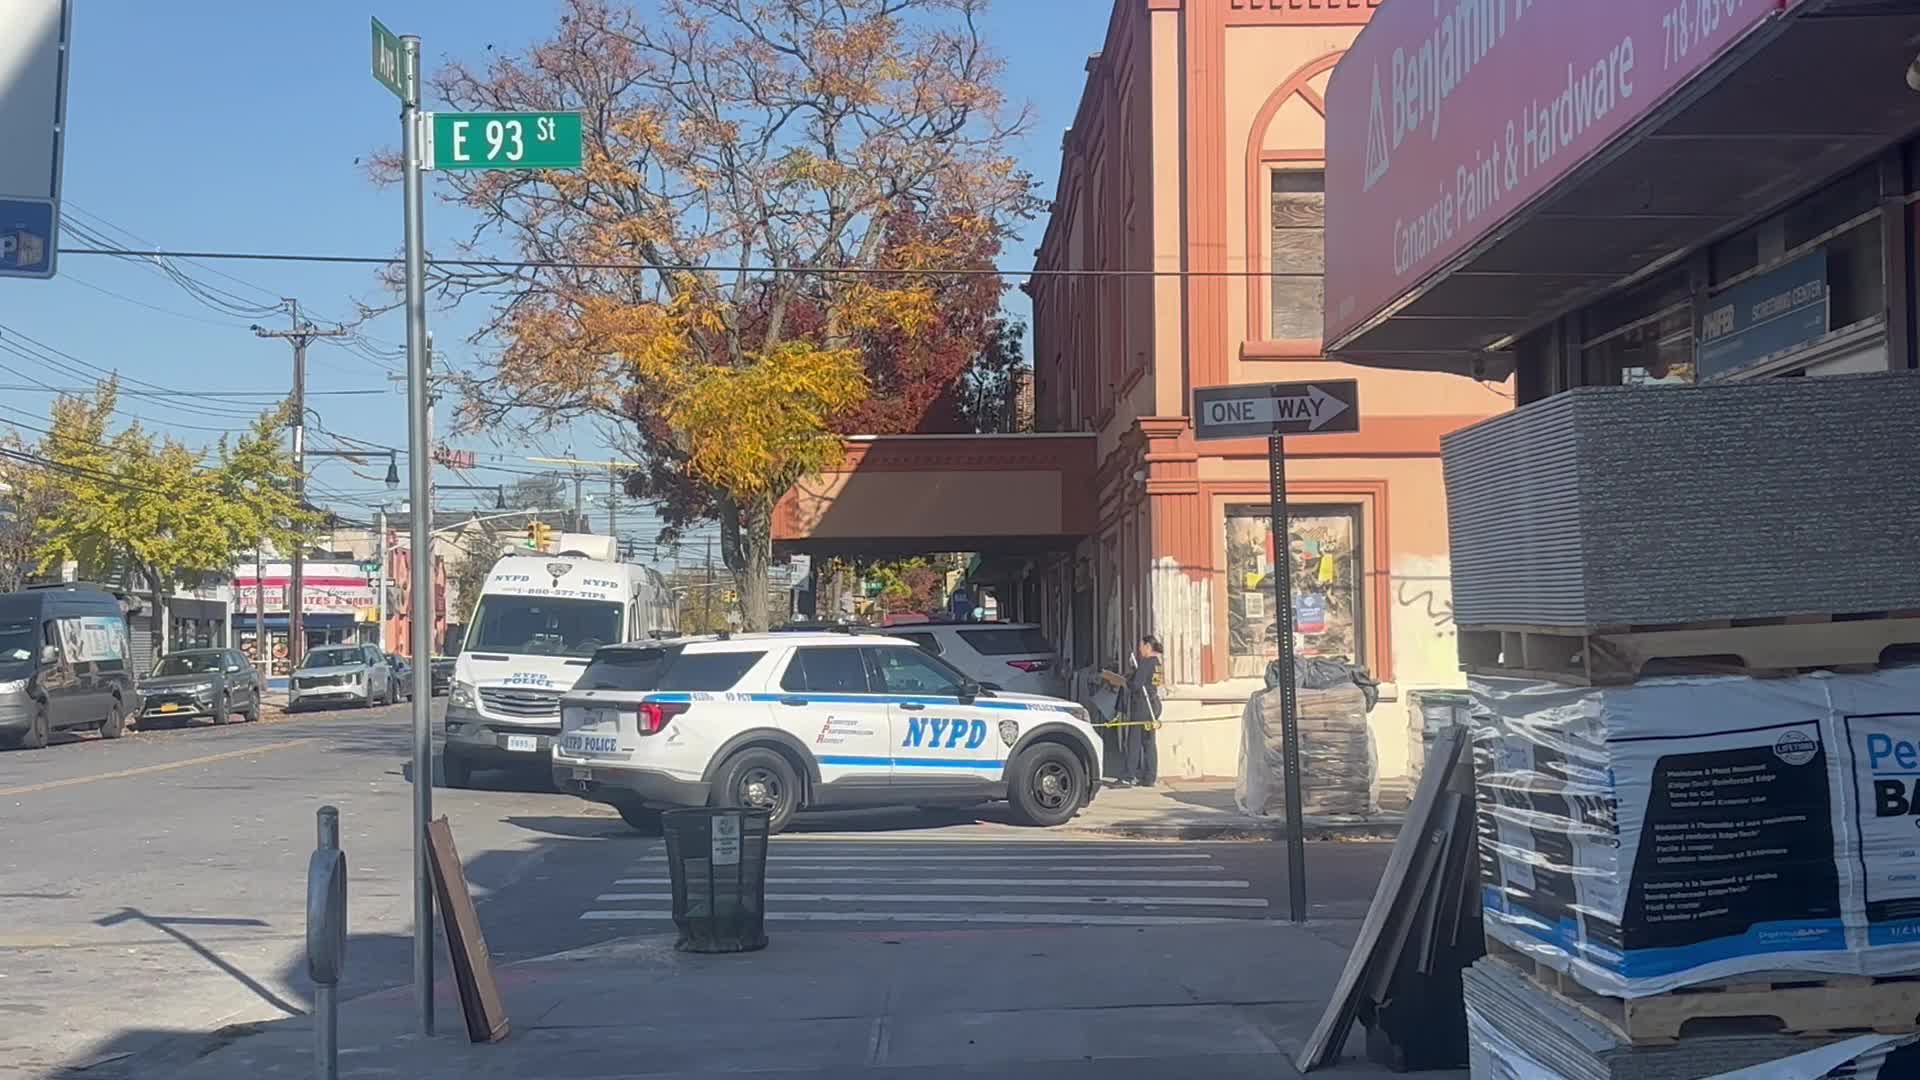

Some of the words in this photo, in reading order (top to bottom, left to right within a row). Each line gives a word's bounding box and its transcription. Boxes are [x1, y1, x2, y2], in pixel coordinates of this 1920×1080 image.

[379, 31, 395, 83] Ave
[453, 121, 470, 161] E
[486, 120, 523, 161] 93
[537, 117, 556, 141] St
[1393, 180, 1453, 277] Canarsie
[1456, 139, 1500, 230] Paint
[1504, 119, 1519, 191] &
[1523, 35, 1634, 177] Hardware
[1211, 401, 1255, 423] ONE
[1277, 398, 1325, 419] WAY
[583, 578, 619, 589] NYPD
[503, 678, 554, 688] POLICE
[1027, 703, 1058, 712] POLICE
[585, 737, 616, 752] POLICE
[902, 717, 987, 748] NYPD
[1866, 733, 1920, 769] Pe
